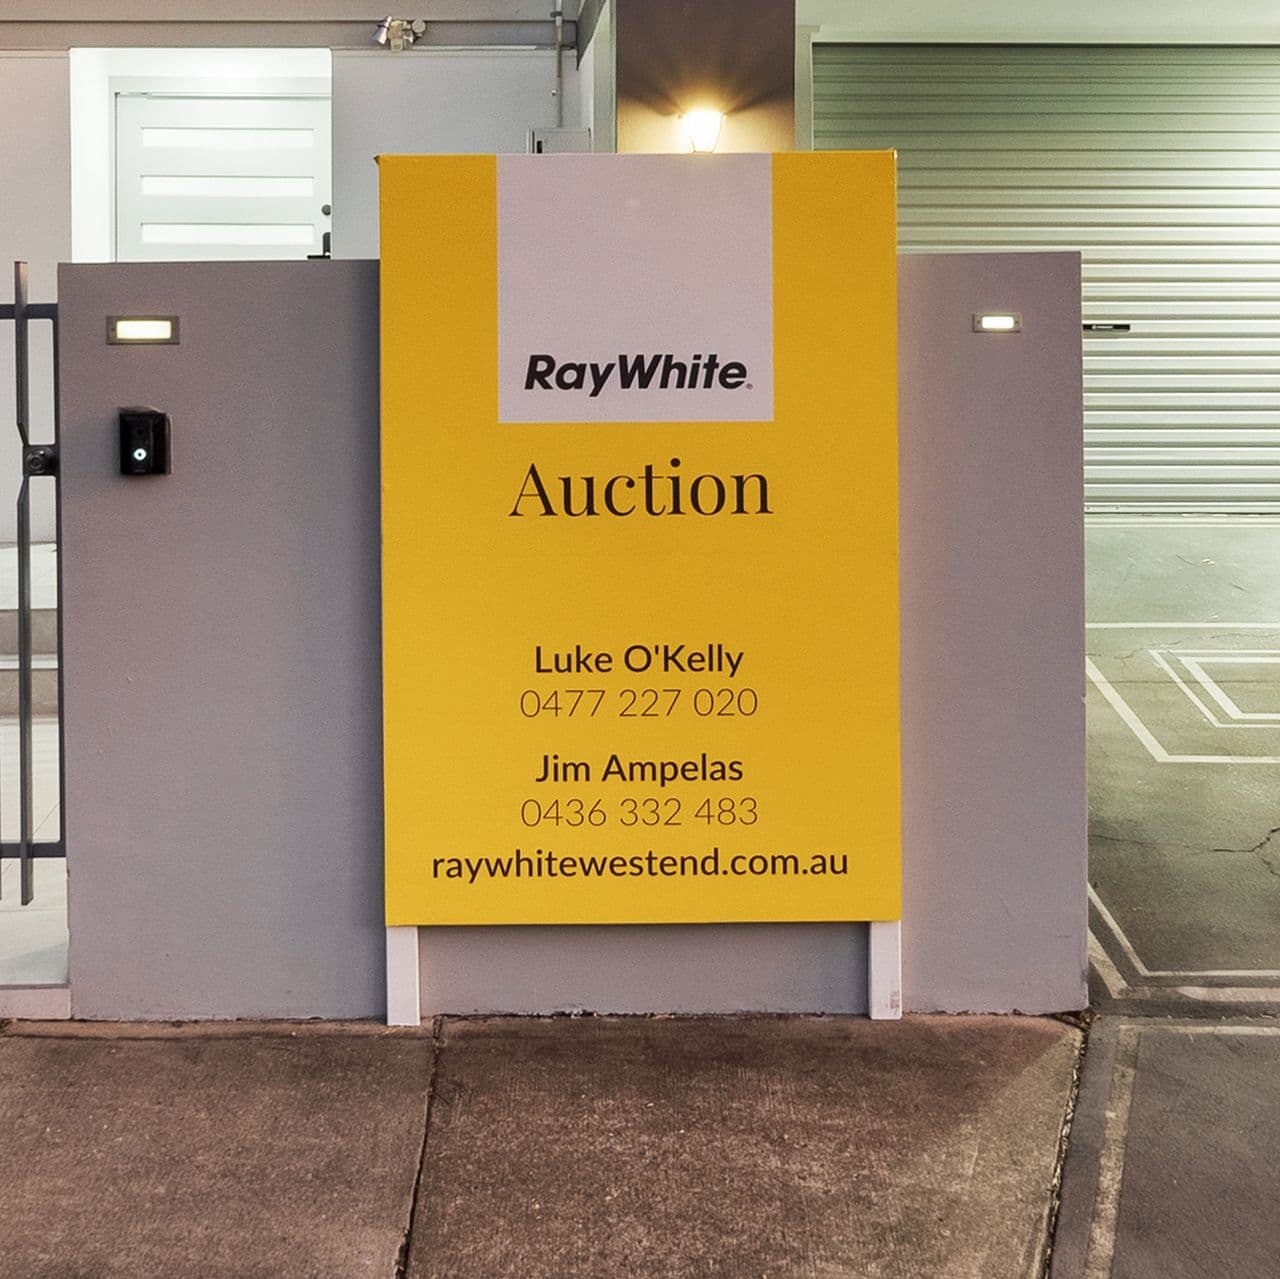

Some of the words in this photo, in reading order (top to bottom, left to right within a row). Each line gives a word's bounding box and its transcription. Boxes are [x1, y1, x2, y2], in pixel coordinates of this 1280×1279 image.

[508, 457, 774, 517] Auction
[535, 644, 613, 674] Luke
[623, 643, 745, 679] O'Kelly
[520, 689, 606, 718] 0477
[619, 688, 682, 717] 227
[693, 687, 758, 717] 020
[535, 753, 591, 783] Jim
[601, 752, 744, 789] Ampelas
[521, 798, 607, 828] 0436
[620, 797, 682, 827] 332
[694, 796, 758, 826] 483
[432, 846, 848, 885] raywhitewestend.com.au
